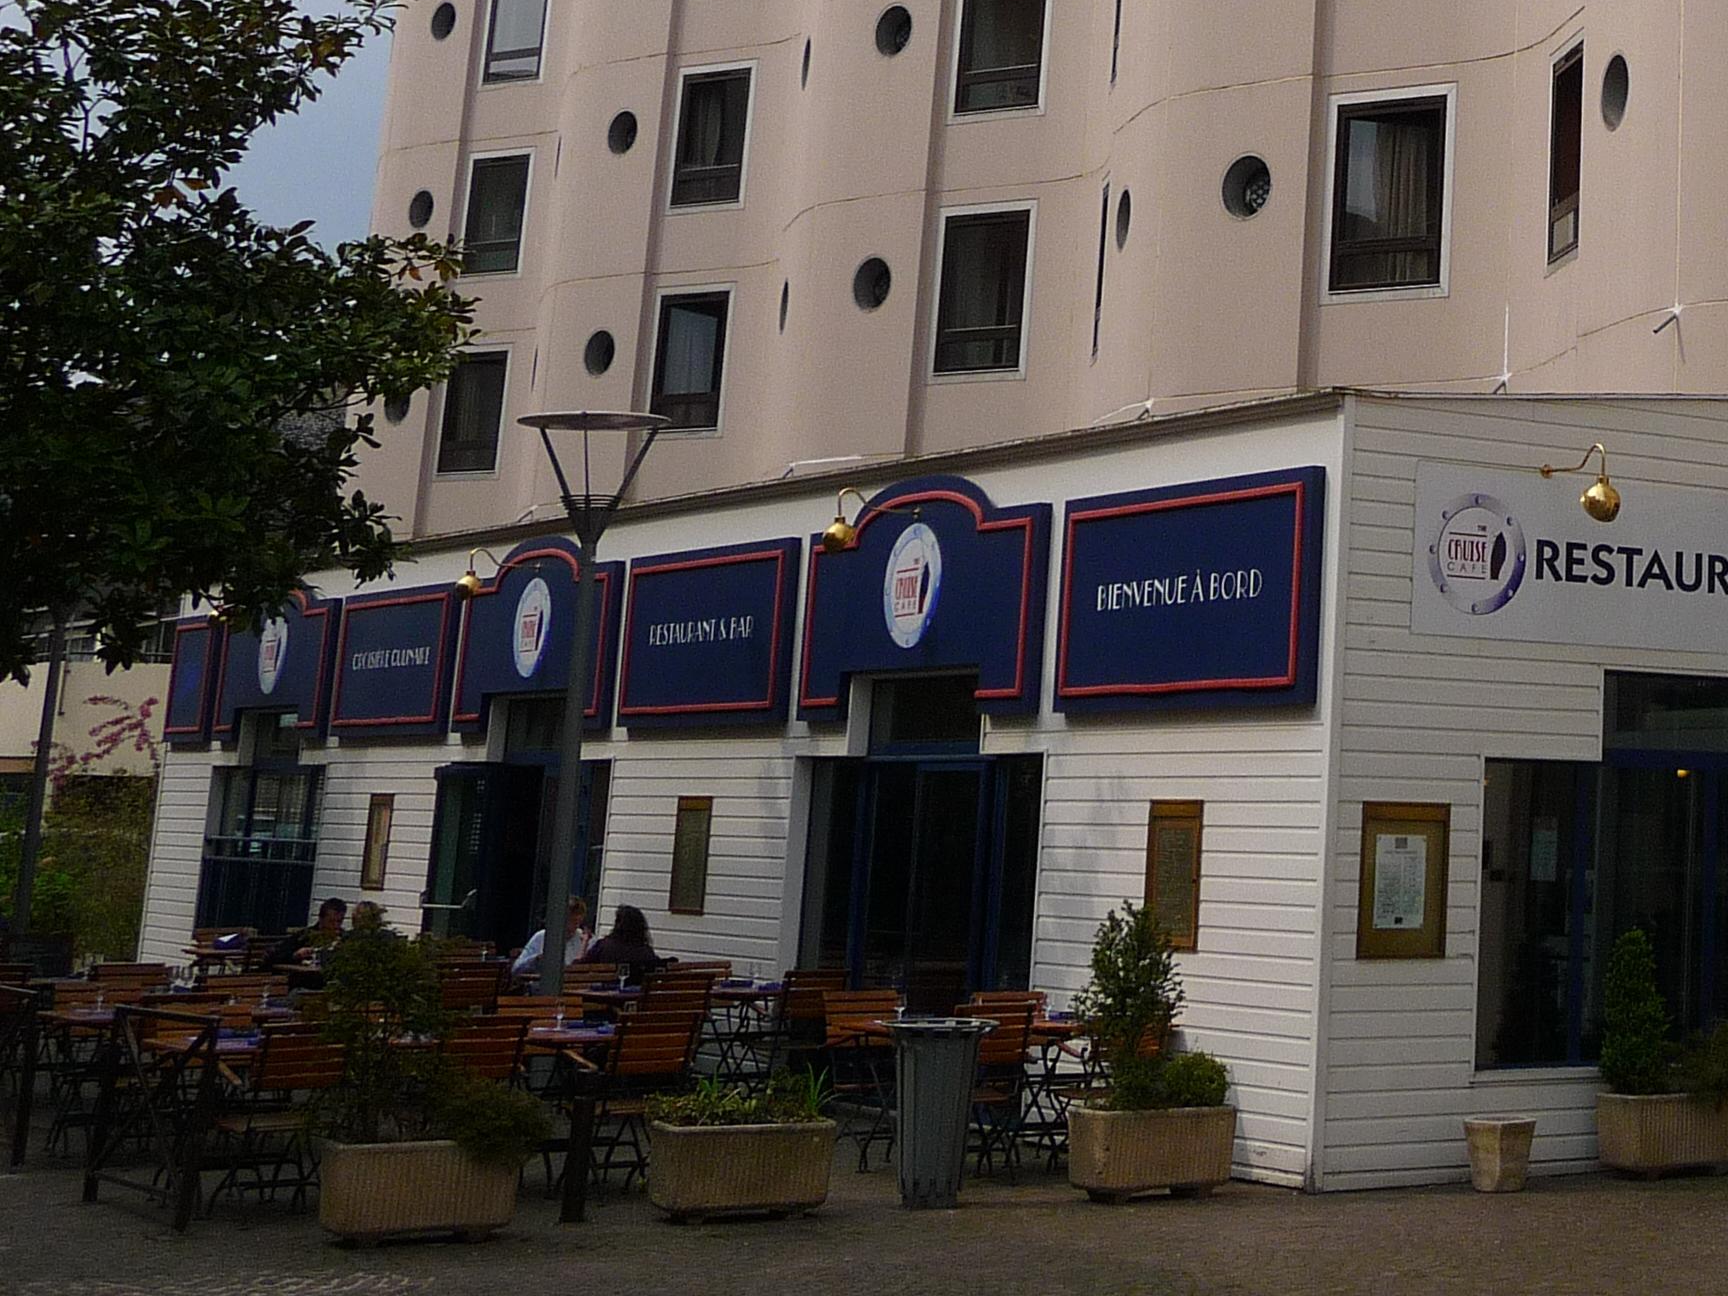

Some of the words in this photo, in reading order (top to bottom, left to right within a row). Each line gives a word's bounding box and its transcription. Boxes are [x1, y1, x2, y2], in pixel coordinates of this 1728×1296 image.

[1448, 539, 1487, 563] CRUISE
[1097, 575, 1188, 612] BIENVENUE
[1209, 568, 1264, 601] BORD
[648, 618, 717, 647] RESTAURANT
[729, 615, 755, 641] BAR
